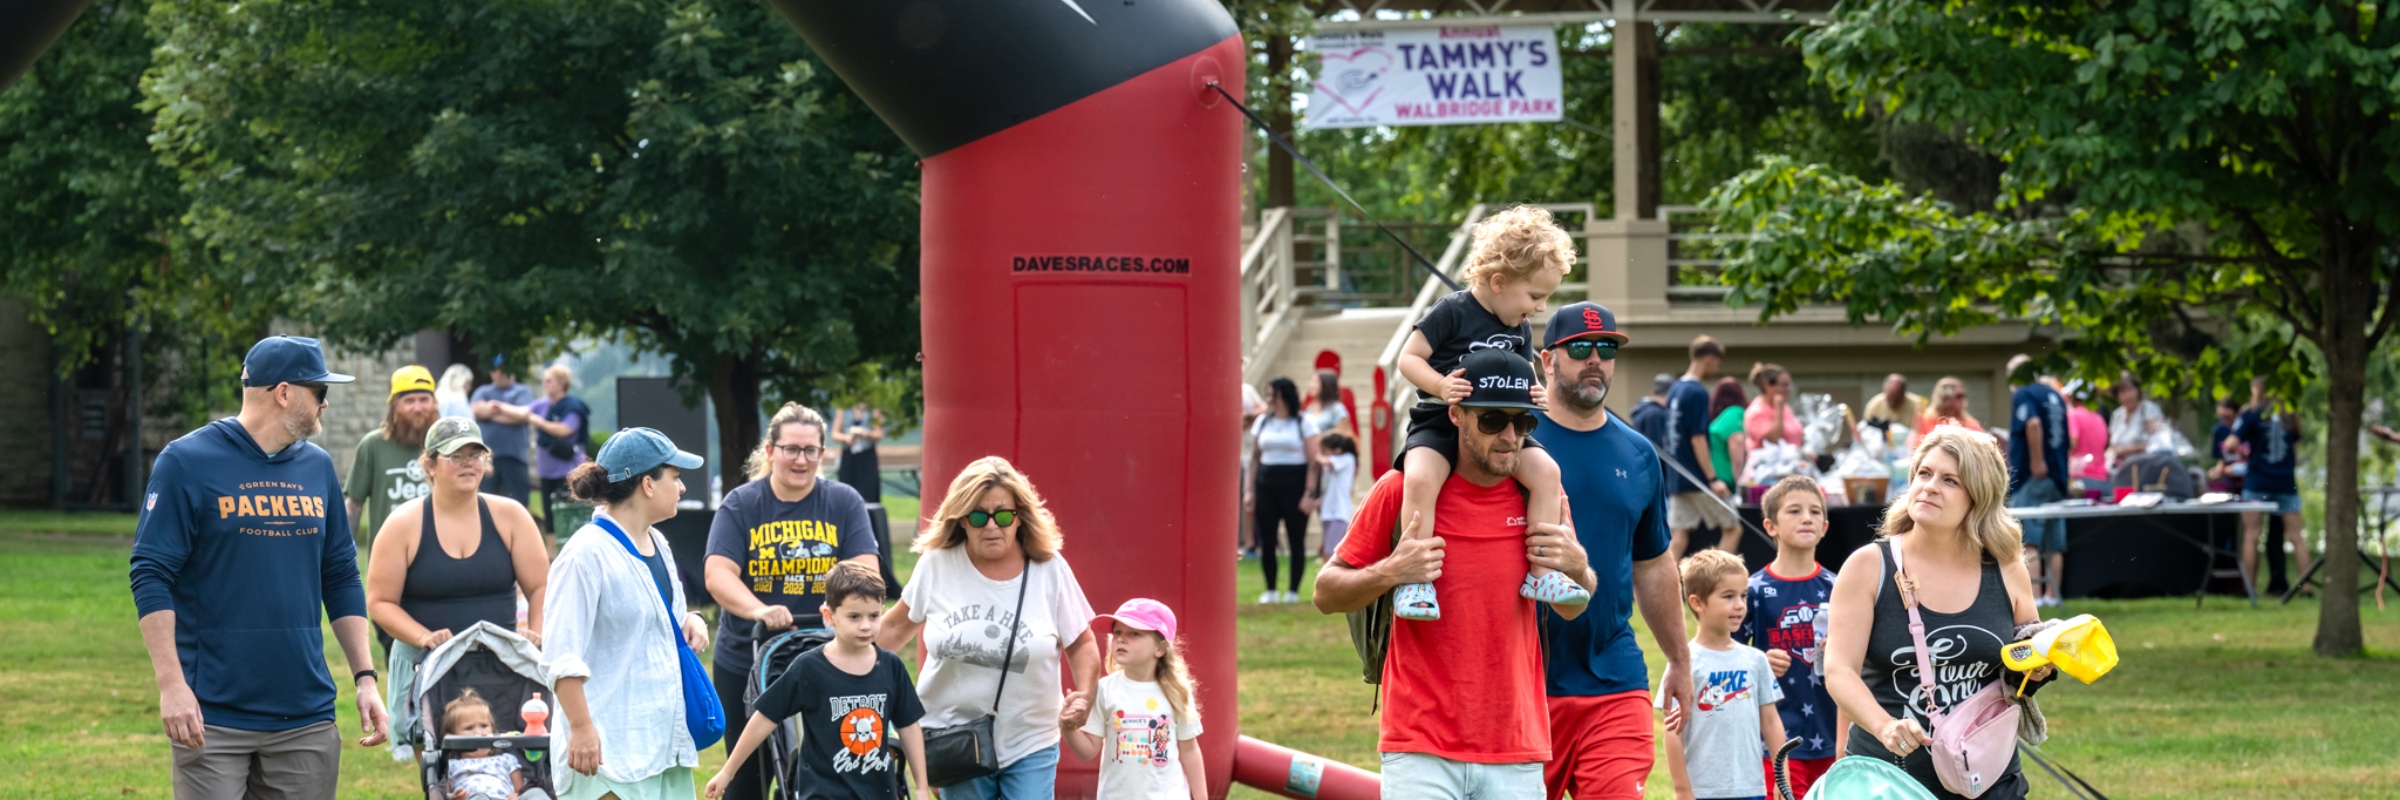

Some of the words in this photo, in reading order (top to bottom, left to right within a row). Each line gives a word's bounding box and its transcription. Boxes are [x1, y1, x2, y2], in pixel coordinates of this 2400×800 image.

[1397, 41, 1548, 71] TAMMY'S
[1427, 71, 1525, 100] WALK
[1395, 102, 1503, 119] WALBRIDGE
[1508, 99, 1557, 116] PARK
[1013, 256, 1190, 273] DAVESRACES.COM
[1479, 375, 1529, 391] STOLEN
[245, 481, 278, 490] GREEN
[387, 477, 431, 500] Jee
[218, 495, 324, 519] PACKERS
[239, 527, 292, 537] FOOTBALL
[296, 527, 319, 535] CLUB
[749, 520, 838, 550] MICHIGAN
[759, 546, 776, 559] M
[749, 557, 838, 577] CHAMPIONS
[754, 581, 773, 593] 2021
[785, 574, 805, 582] BACK
[783, 581, 805, 595] 2022
[811, 581, 827, 594] 202
[944, 604, 980, 629] TAKE
[985, 605, 995, 621] A
[1771, 629, 1814, 643] BASEB
[1708, 670, 1748, 693] NIKE
[830, 693, 888, 722] DETROIT
